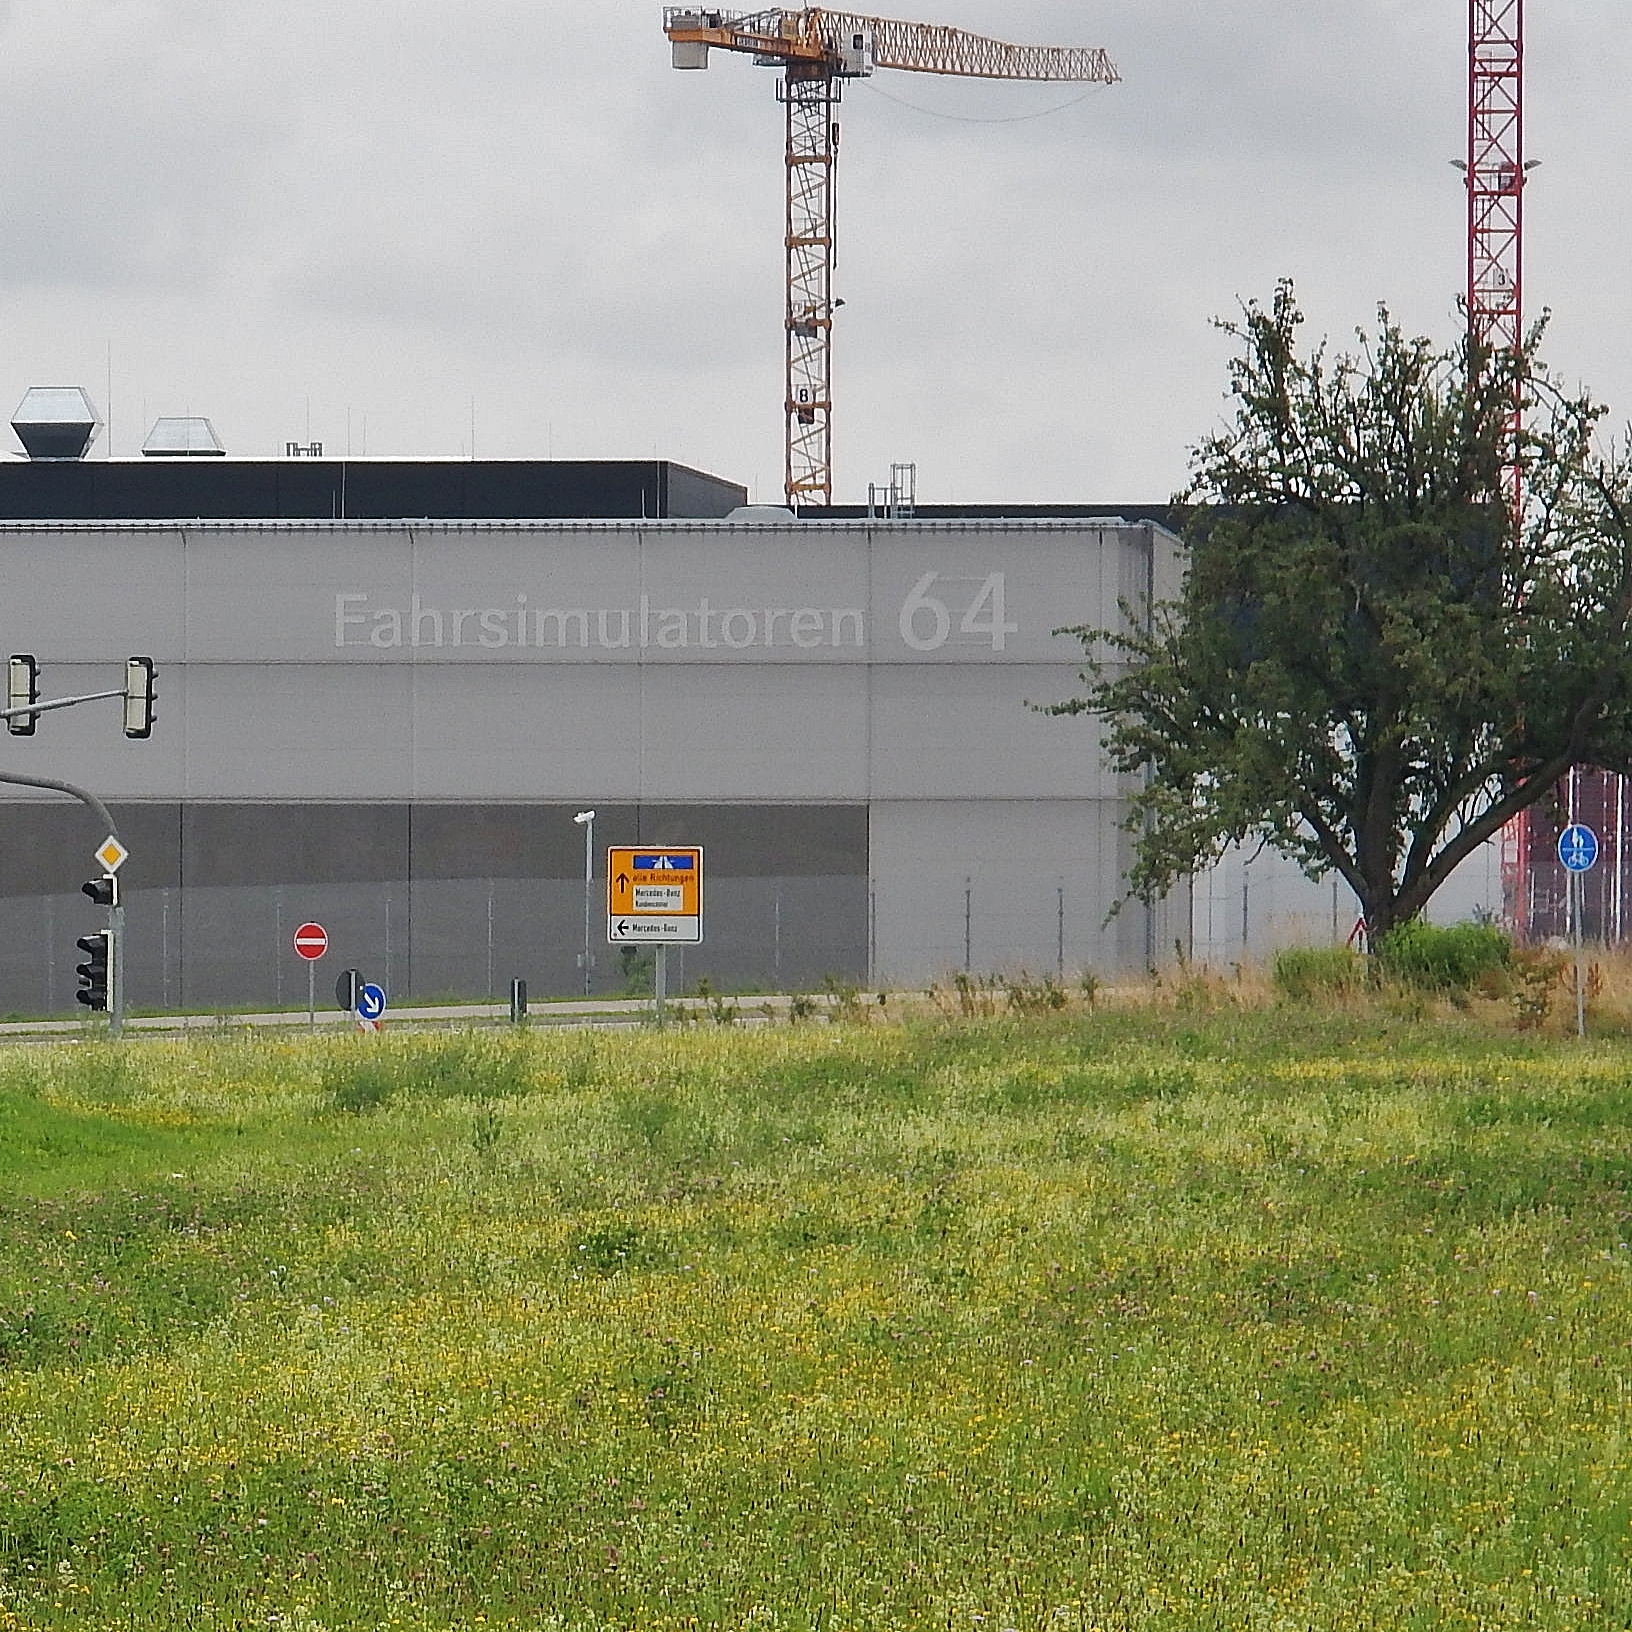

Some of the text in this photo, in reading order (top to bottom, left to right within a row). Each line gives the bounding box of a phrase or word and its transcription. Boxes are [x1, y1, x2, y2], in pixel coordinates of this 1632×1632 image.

[799, 388, 809, 403] 8
[334, 569, 1019, 651] Fahrsimulatoren 64
[650, 872, 695, 884] Richtungen
